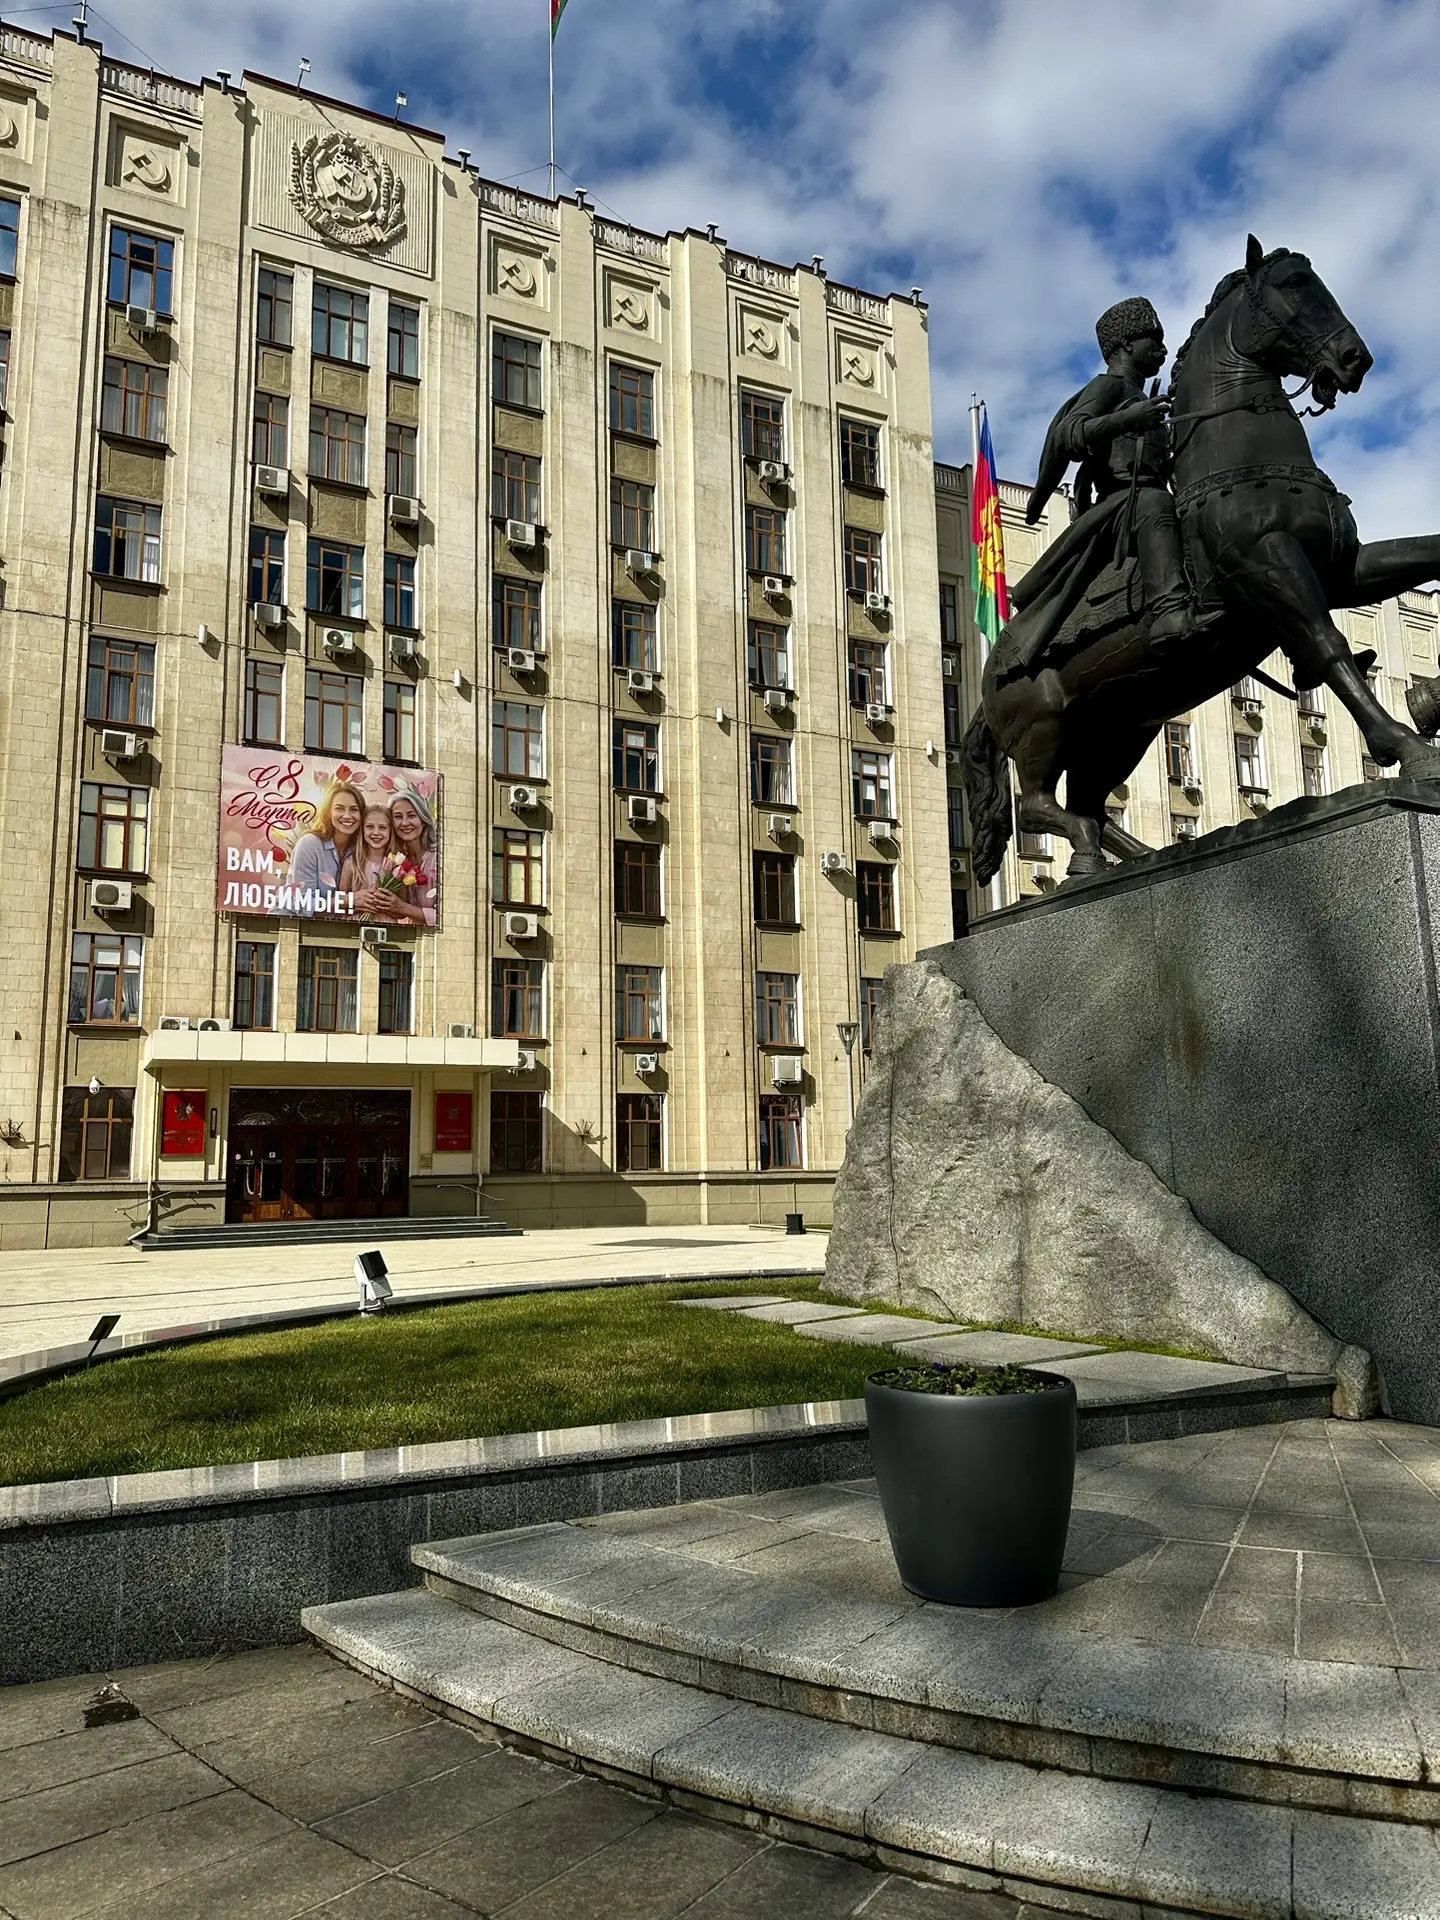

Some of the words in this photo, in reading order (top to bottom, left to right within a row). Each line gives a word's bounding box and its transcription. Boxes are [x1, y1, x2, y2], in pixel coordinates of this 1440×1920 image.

[277, 760, 304, 800] 8
[227, 792, 317, 830] Марта
[226, 846, 282, 879] ВАМ,
[223, 881, 355, 915] ЛЮБИМЫЕ!
